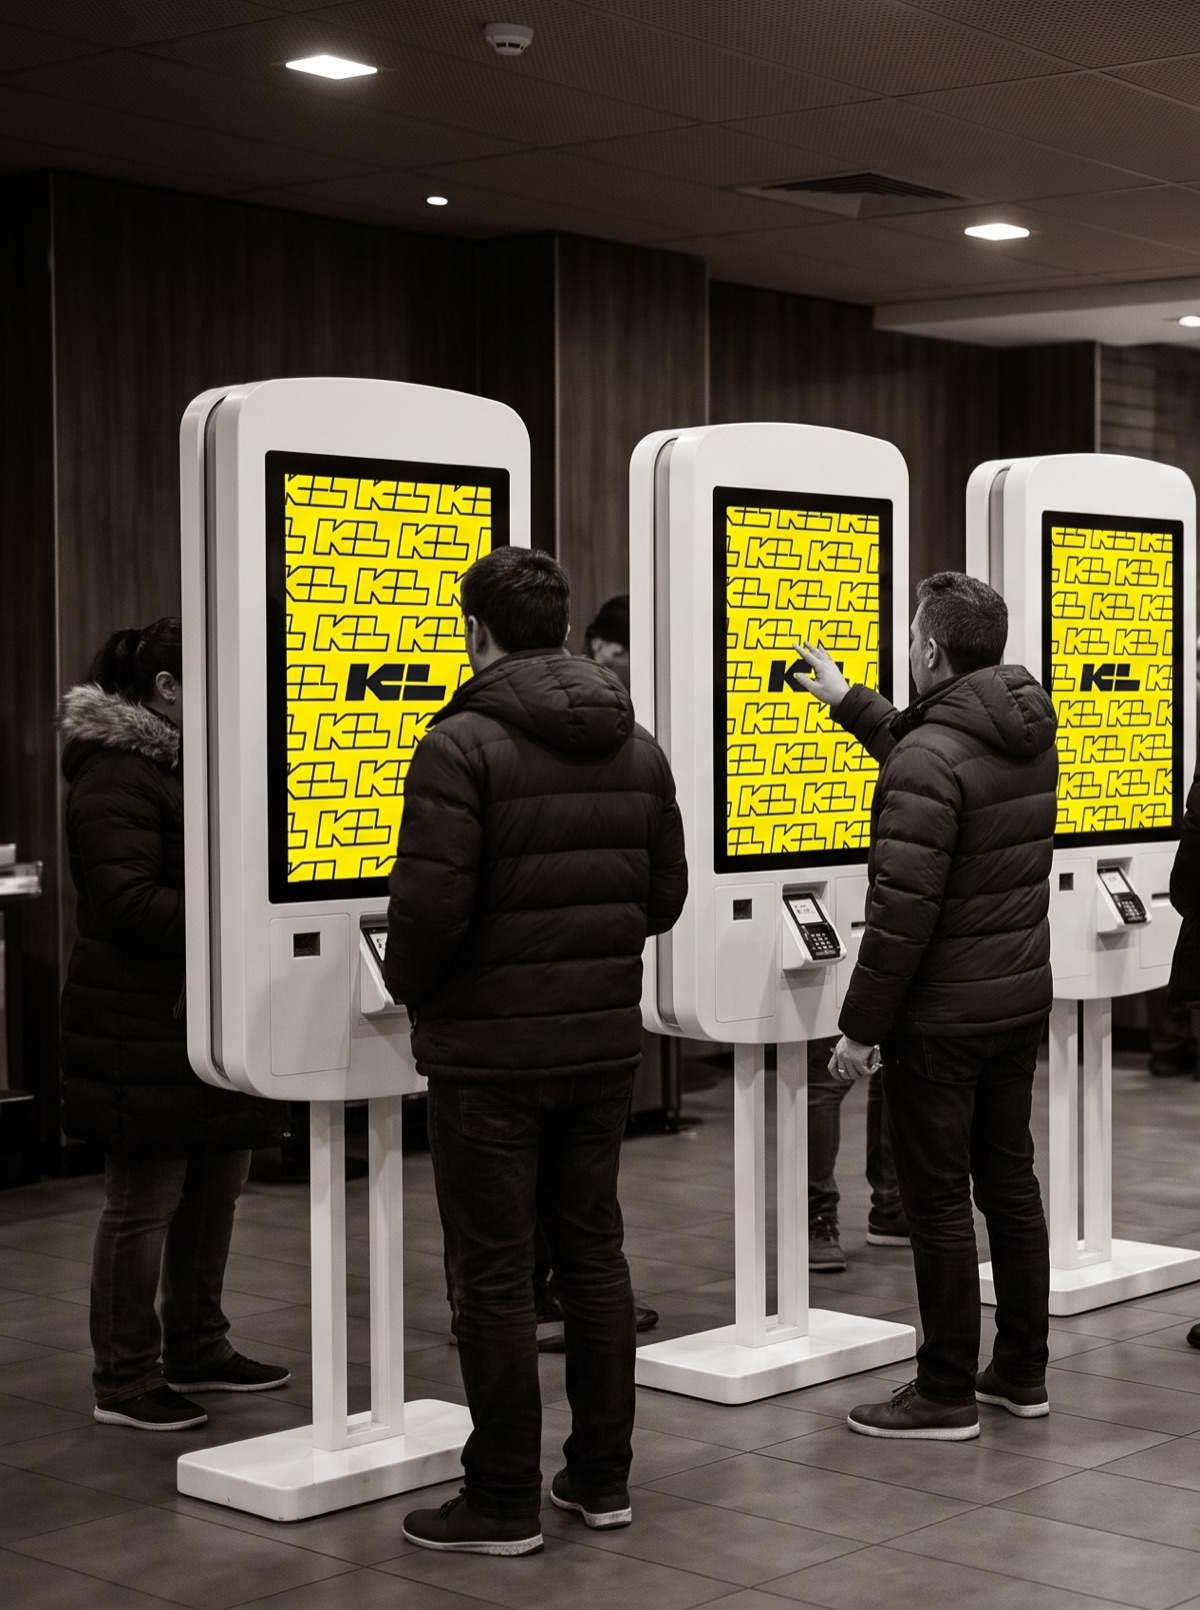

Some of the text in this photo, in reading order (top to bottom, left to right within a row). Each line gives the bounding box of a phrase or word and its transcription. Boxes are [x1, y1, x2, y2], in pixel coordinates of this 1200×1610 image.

[313, 518, 390, 558] KL
[397, 522, 469, 561] KL
[745, 537, 802, 570] KL
[807, 540, 862, 573] KL
[354, 567, 430, 606] KL
[1064, 556, 1111, 585] KL
[1115, 559, 1159, 587] KL
[775, 578, 831, 611] KL
[1089, 592, 1135, 621] KL
[313, 614, 390, 652] KL
[1063, 627, 1109, 655] KL
[1113, 629, 1158, 656] KL
[345, 664, 446, 701] KL
[768, 659, 850, 692] K
[1080, 664, 1140, 691] KL
[1146, 665, 1172, 691] K
[741, 702, 799, 735] KL
[1106, 700, 1152, 727] KL
[314, 713, 390, 750] KL
[771, 742, 827, 775] KL
[1080, 735, 1126, 764] KL
[737, 784, 796, 817] KL
[801, 781, 856, 814] KL
[1106, 769, 1150, 798] KL
[1154, 769, 1172, 795] K
[315, 808, 392, 848] KL
